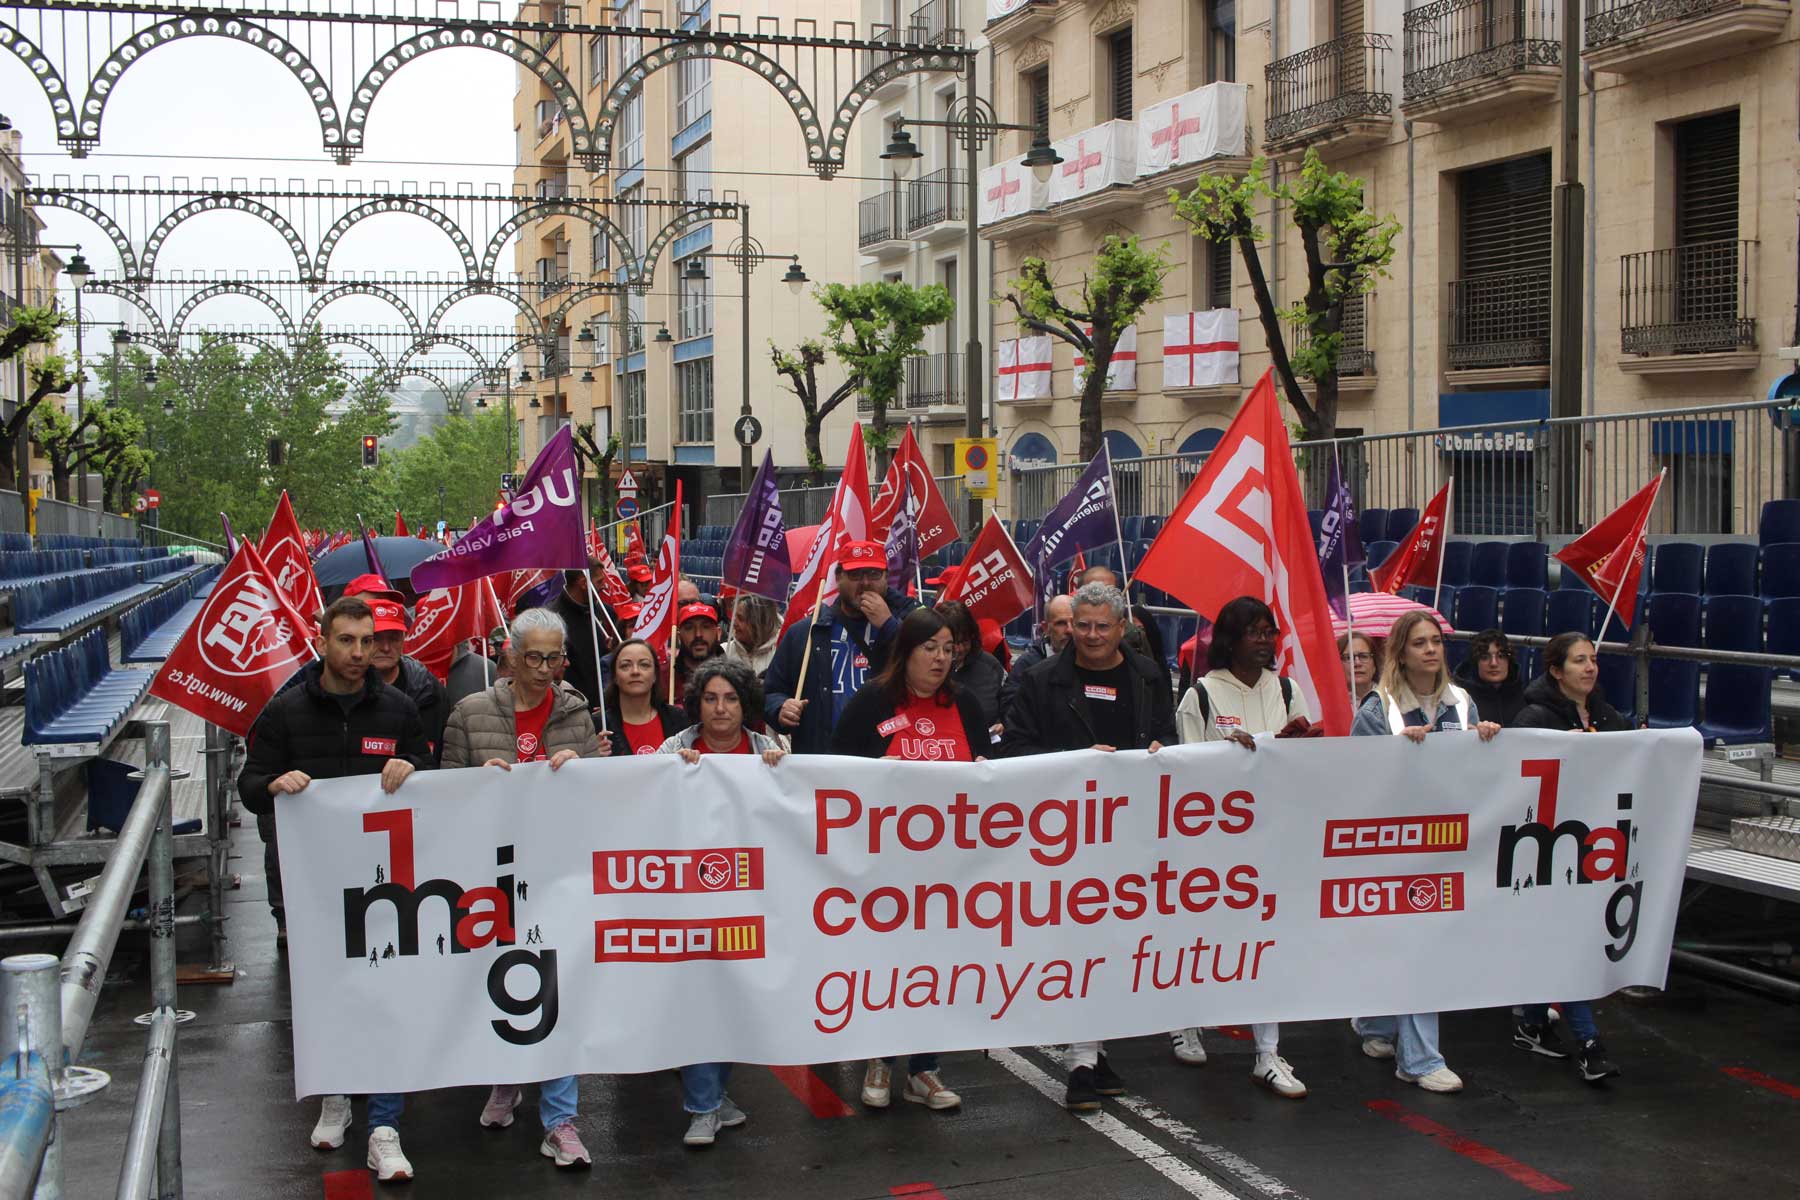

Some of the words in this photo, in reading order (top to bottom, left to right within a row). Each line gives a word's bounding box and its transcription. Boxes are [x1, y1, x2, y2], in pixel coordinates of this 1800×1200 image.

[877, 721, 896, 734] UGT
[364, 741, 384, 750] UGT
[901, 738, 956, 760] UGT
[1520, 758, 1561, 832] 1
[814, 780, 1129, 866] Protegir
[1157, 774, 1255, 839] les
[1331, 823, 1423, 850] CCOO
[362, 808, 415, 884] 1
[607, 856, 692, 889] UGT
[813, 860, 1277, 947] conquestes,
[1332, 880, 1403, 914] UGT
[603, 927, 713, 955] CCOO
[814, 956, 1105, 1034] guanyar
[1131, 934, 1275, 993] futur
